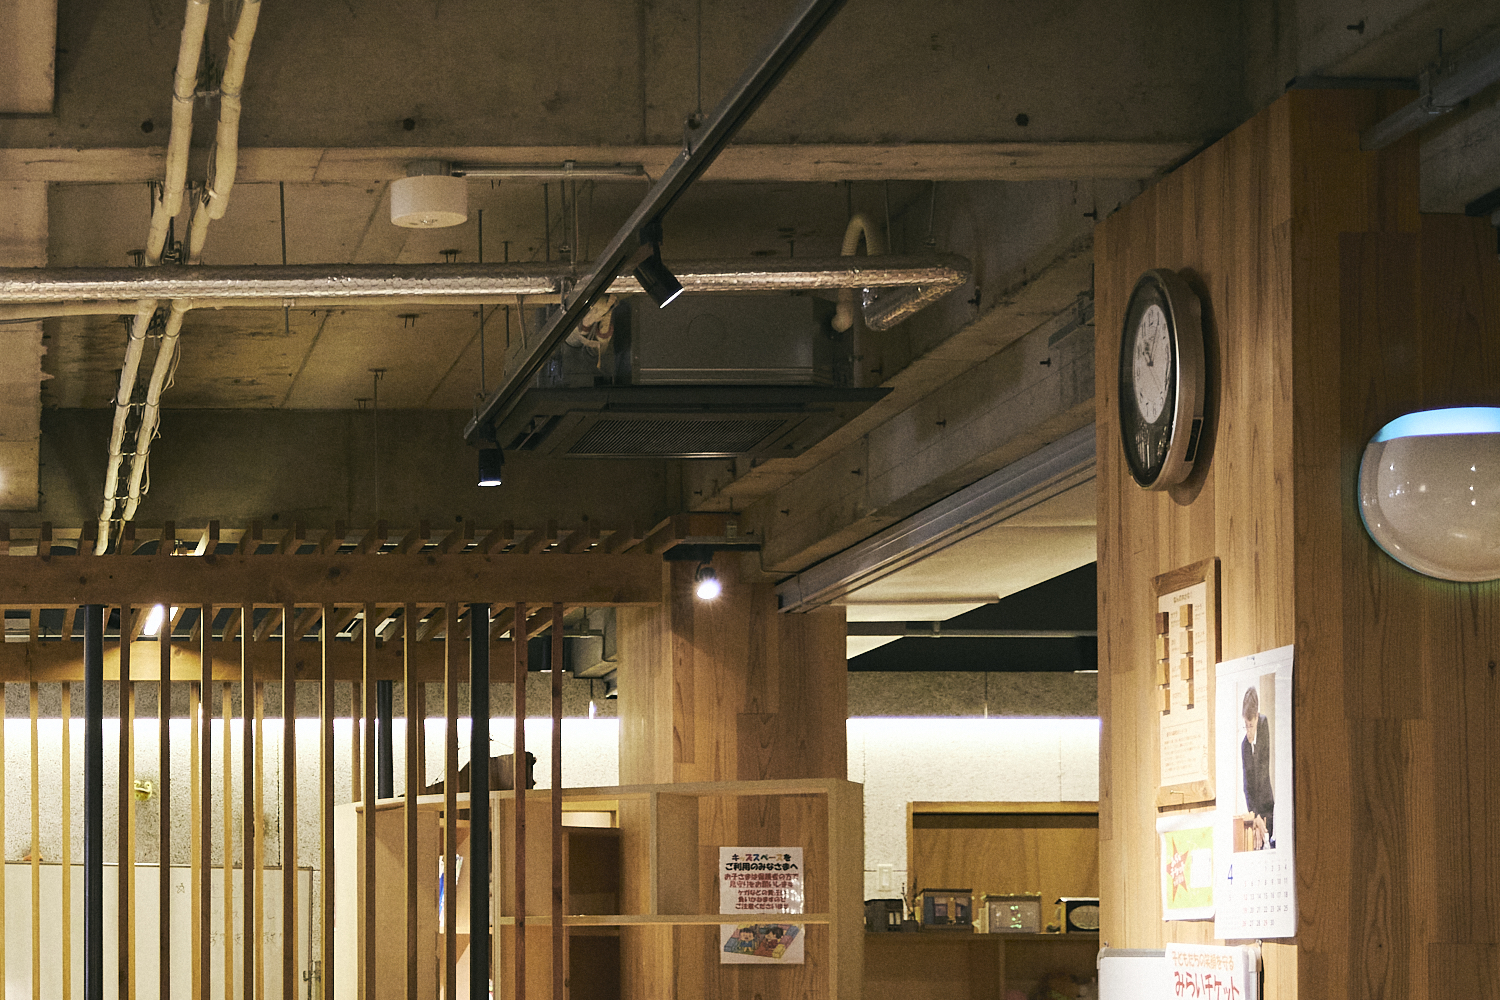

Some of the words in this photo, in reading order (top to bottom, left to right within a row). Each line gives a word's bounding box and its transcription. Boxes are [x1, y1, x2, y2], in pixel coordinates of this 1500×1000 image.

[725, 863, 798, 871] ご利用のみなさまへ
[1228, 864, 1233, 885] 4
[1172, 951, 1234, 971] 子どもたちの笑顔を守る
